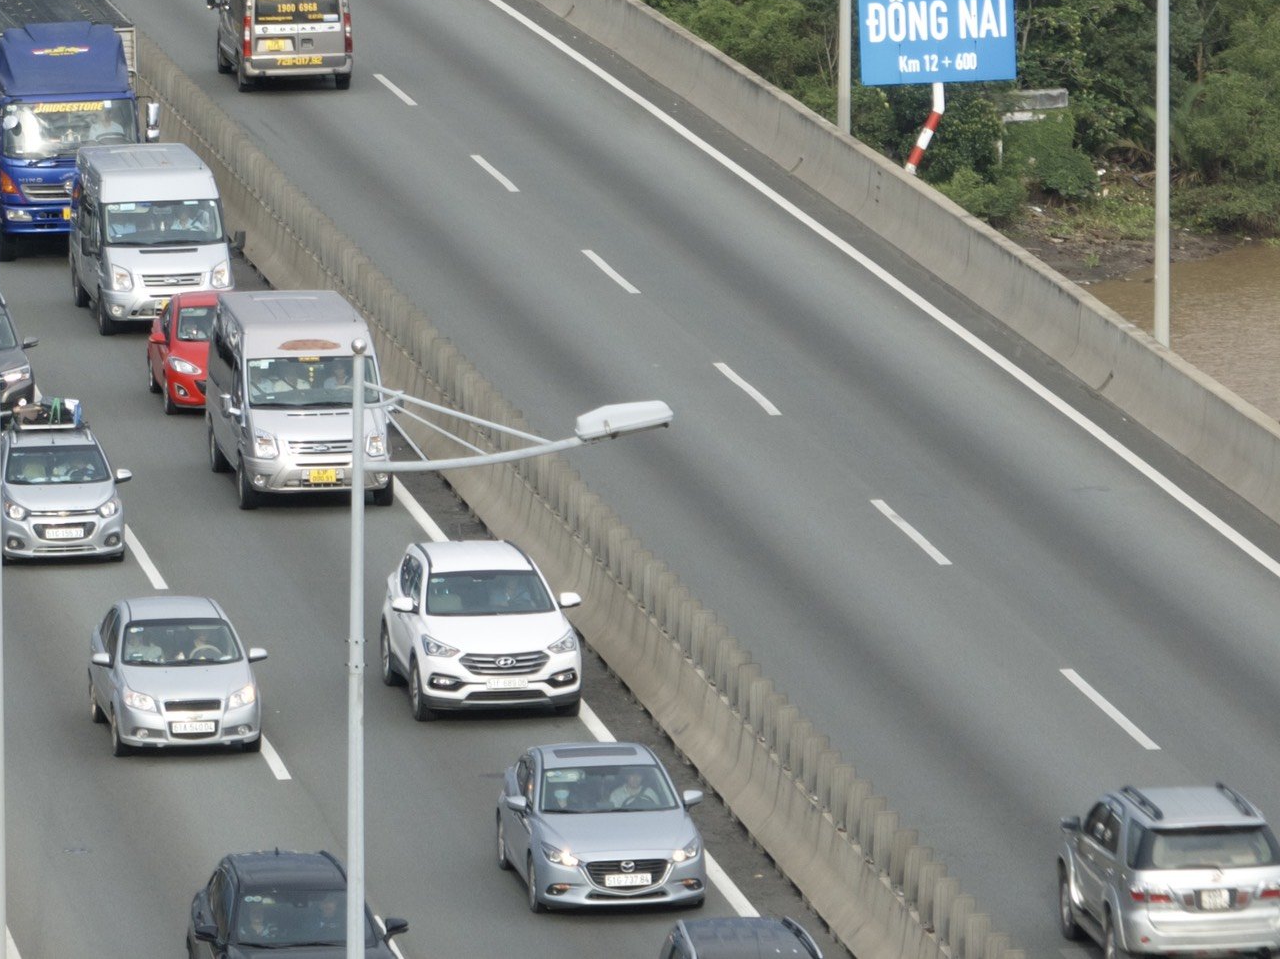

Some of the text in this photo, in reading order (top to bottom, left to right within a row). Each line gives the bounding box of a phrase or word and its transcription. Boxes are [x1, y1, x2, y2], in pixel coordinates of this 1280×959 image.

[277, 3, 296, 13] 1900
[898, 52, 978, 73] Km 12 + 600
